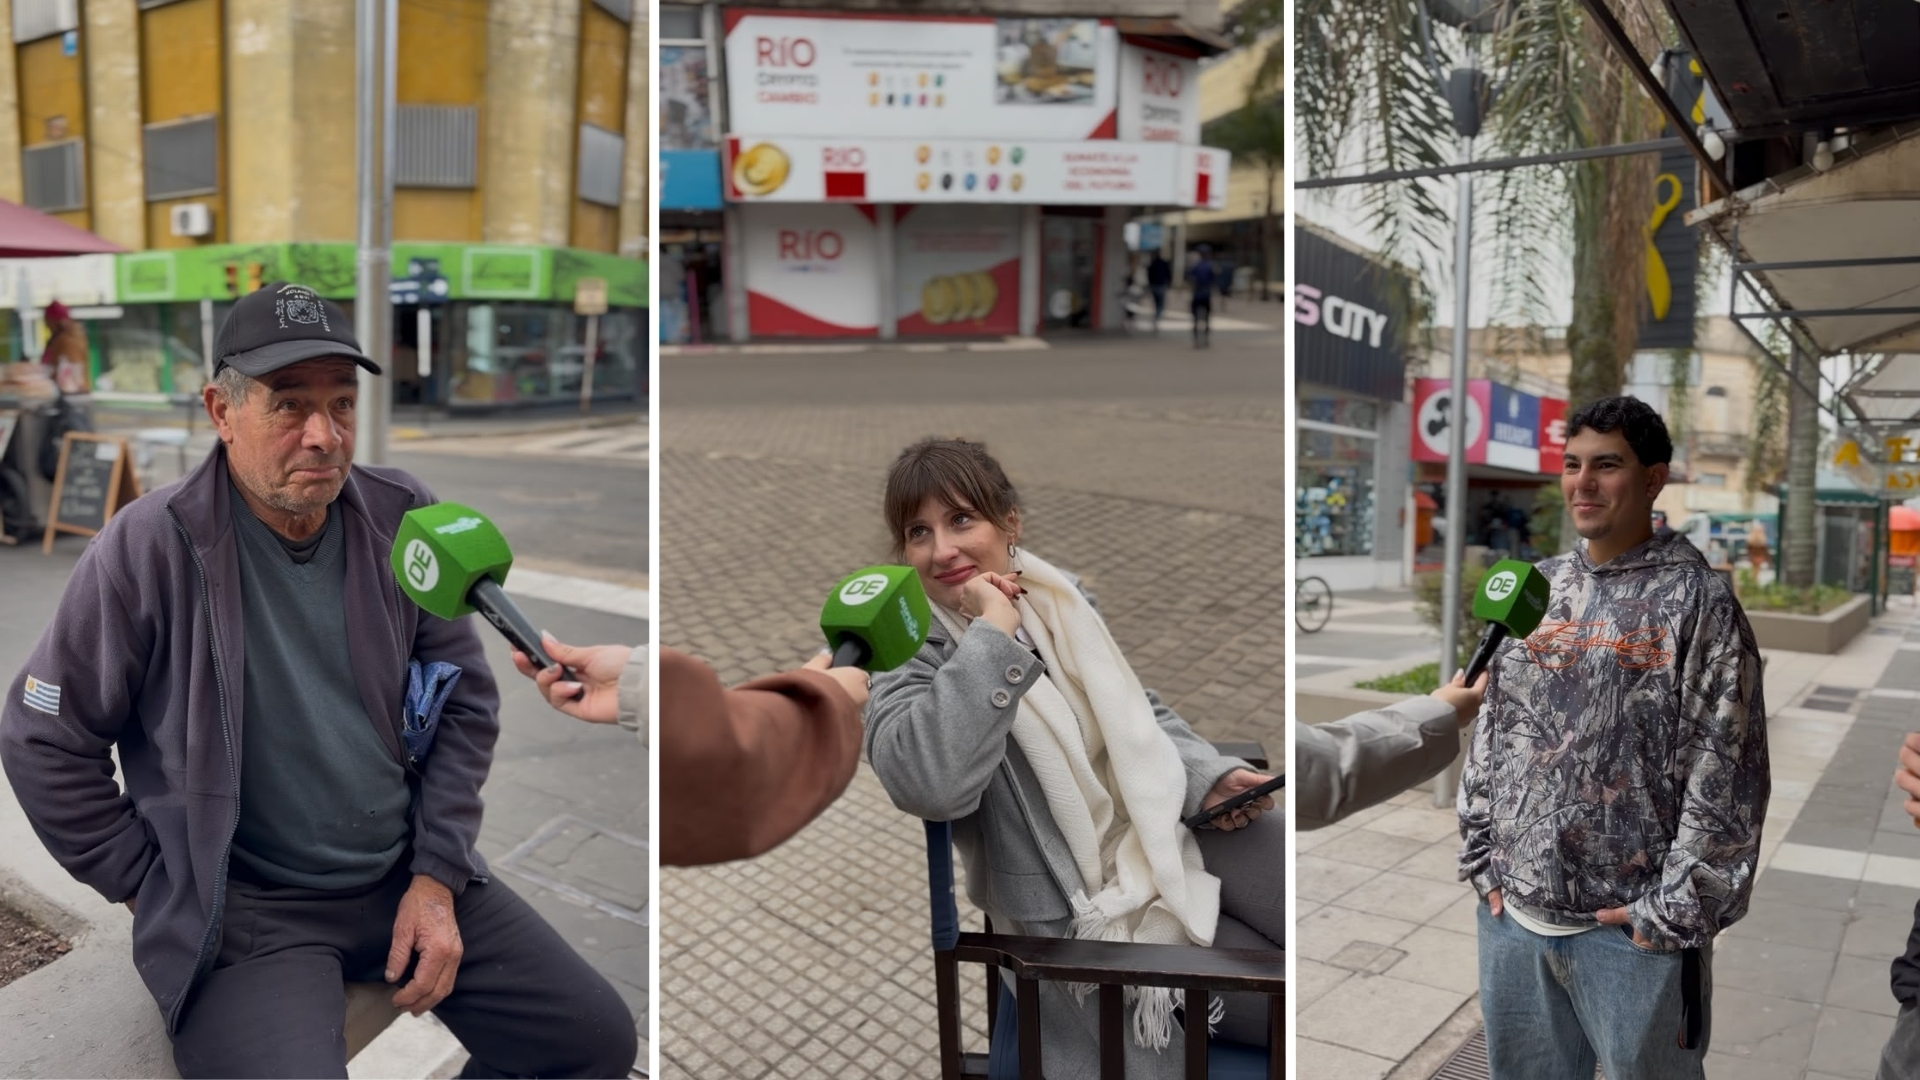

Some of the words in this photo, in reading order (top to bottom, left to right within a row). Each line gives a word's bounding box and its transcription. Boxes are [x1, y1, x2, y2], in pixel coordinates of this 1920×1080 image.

[1322, 295, 1388, 348] CITY
[408, 542, 432, 586] DE
[844, 580, 884, 595] DE
[1488, 577, 1514, 593] DE
